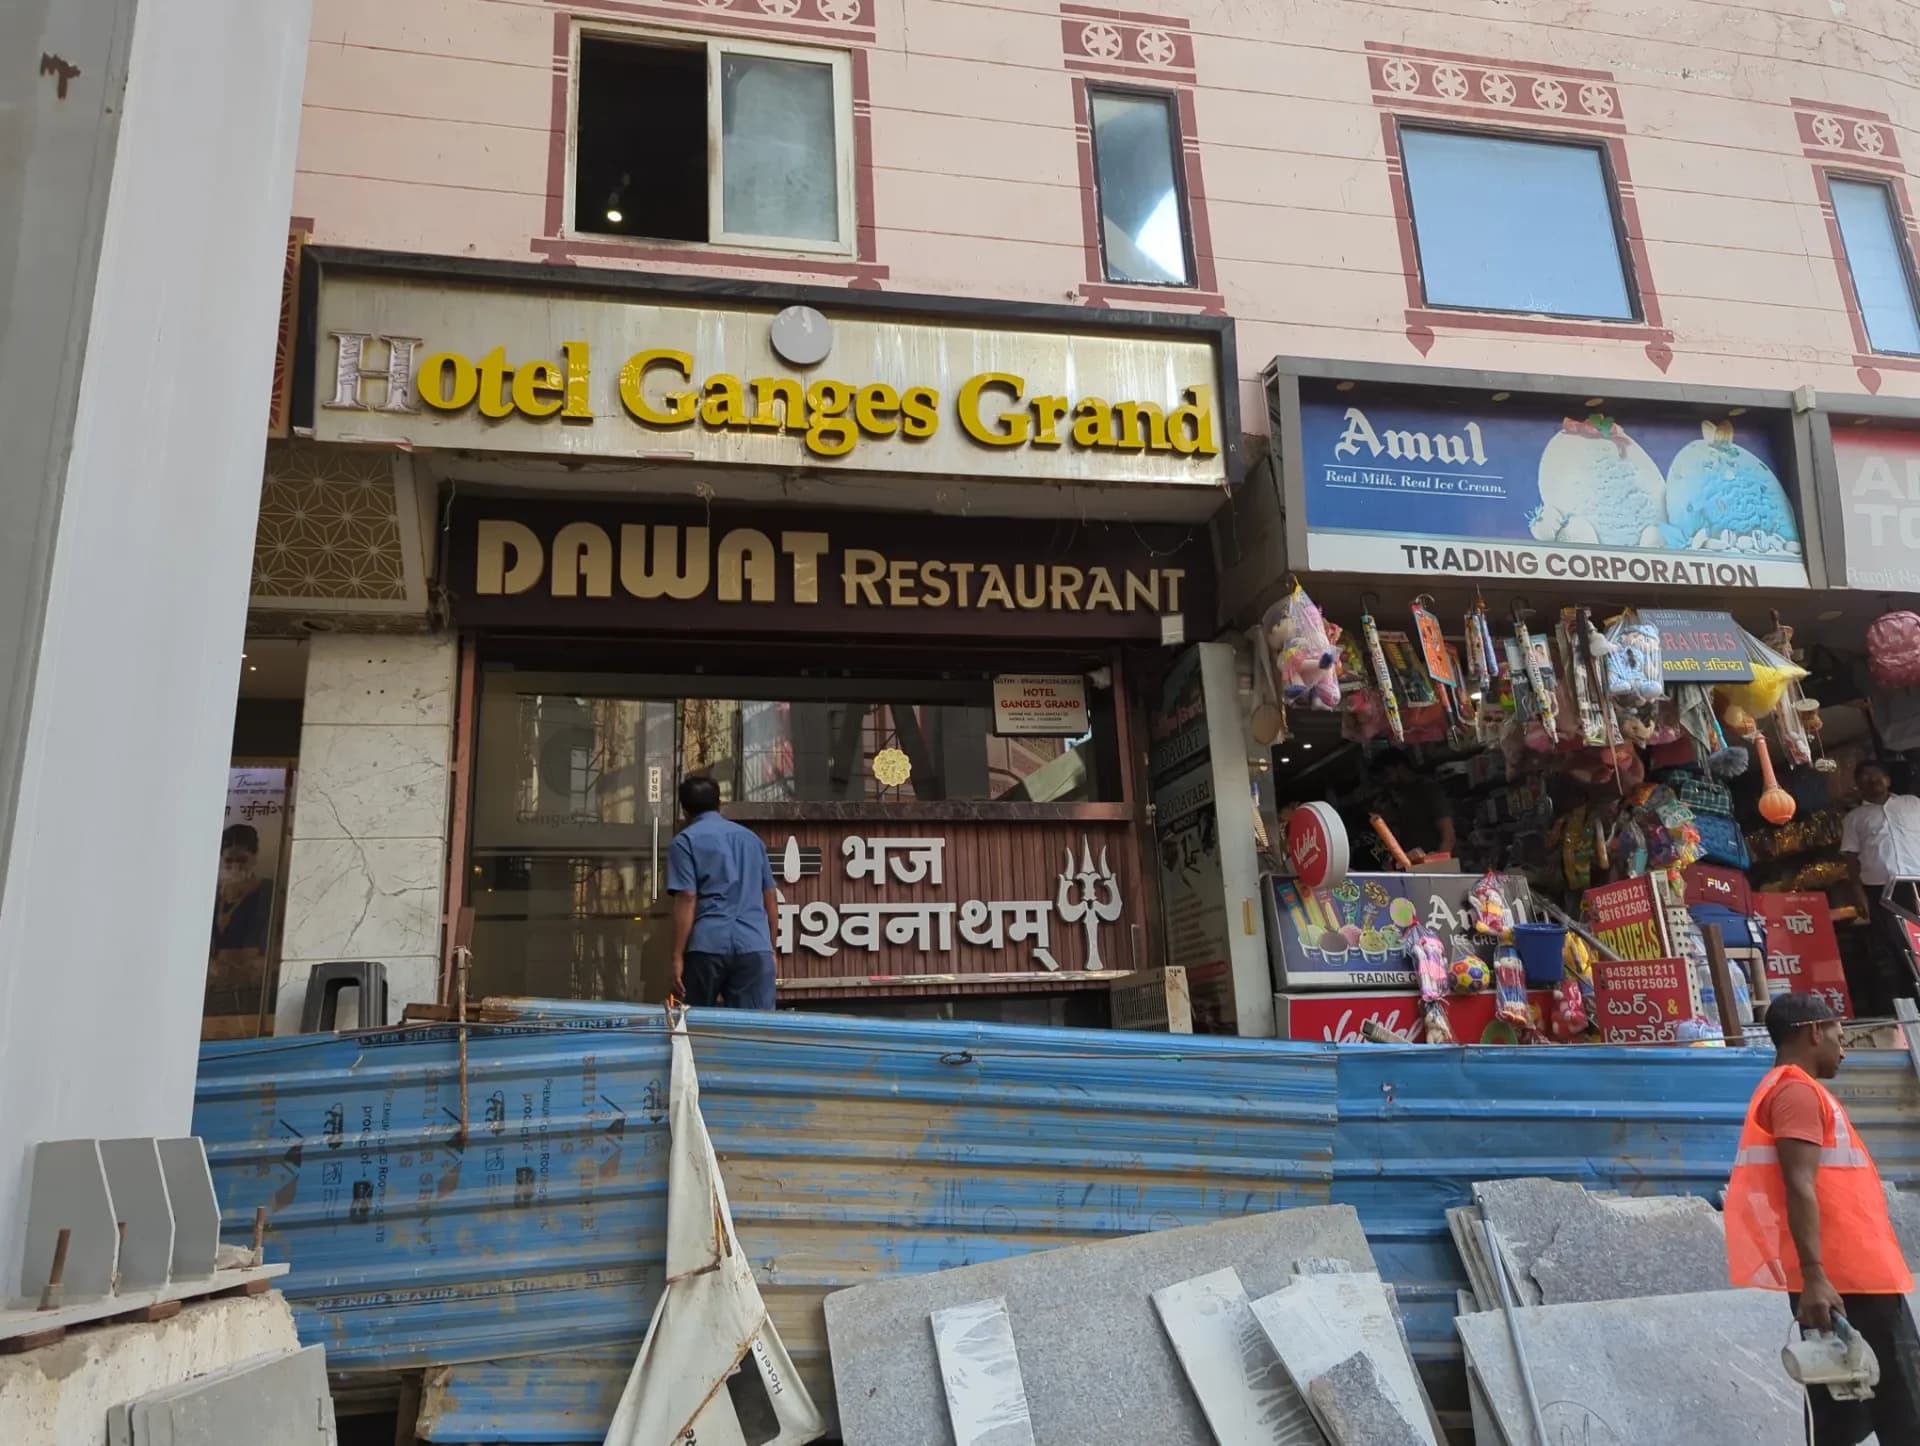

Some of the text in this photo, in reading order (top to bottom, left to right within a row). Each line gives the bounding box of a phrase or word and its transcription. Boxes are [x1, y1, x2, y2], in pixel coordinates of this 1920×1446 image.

[322, 330, 1220, 457] Hotel Ganges Grand
[1334, 407, 1489, 466] Amul
[1325, 469, 1507, 494] Real Milk. Real Ice Cream.
[476, 519, 1186, 613] DAWAT RESTAURANT
[1400, 544, 1760, 588] TRADING CORPORATION
[1662, 631, 1737, 651] RAVELS
[1023, 688, 1057, 697] HOTEL
[1000, 700, 1080, 709] GANGES GRAND
[842, 835, 945, 885] भज
[1707, 878, 1731, 893] FILA
[1595, 884, 1647, 908] 945288121
[1449, 934, 1468, 945] ICE
[1349, 972, 1406, 984] TRADING
[1606, 964, 1676, 978] 9452881211
[1608, 977, 1679, 991] 9616125029
[1667, 998, 1679, 1015] &
[760, 1354, 783, 1396] Hotel
